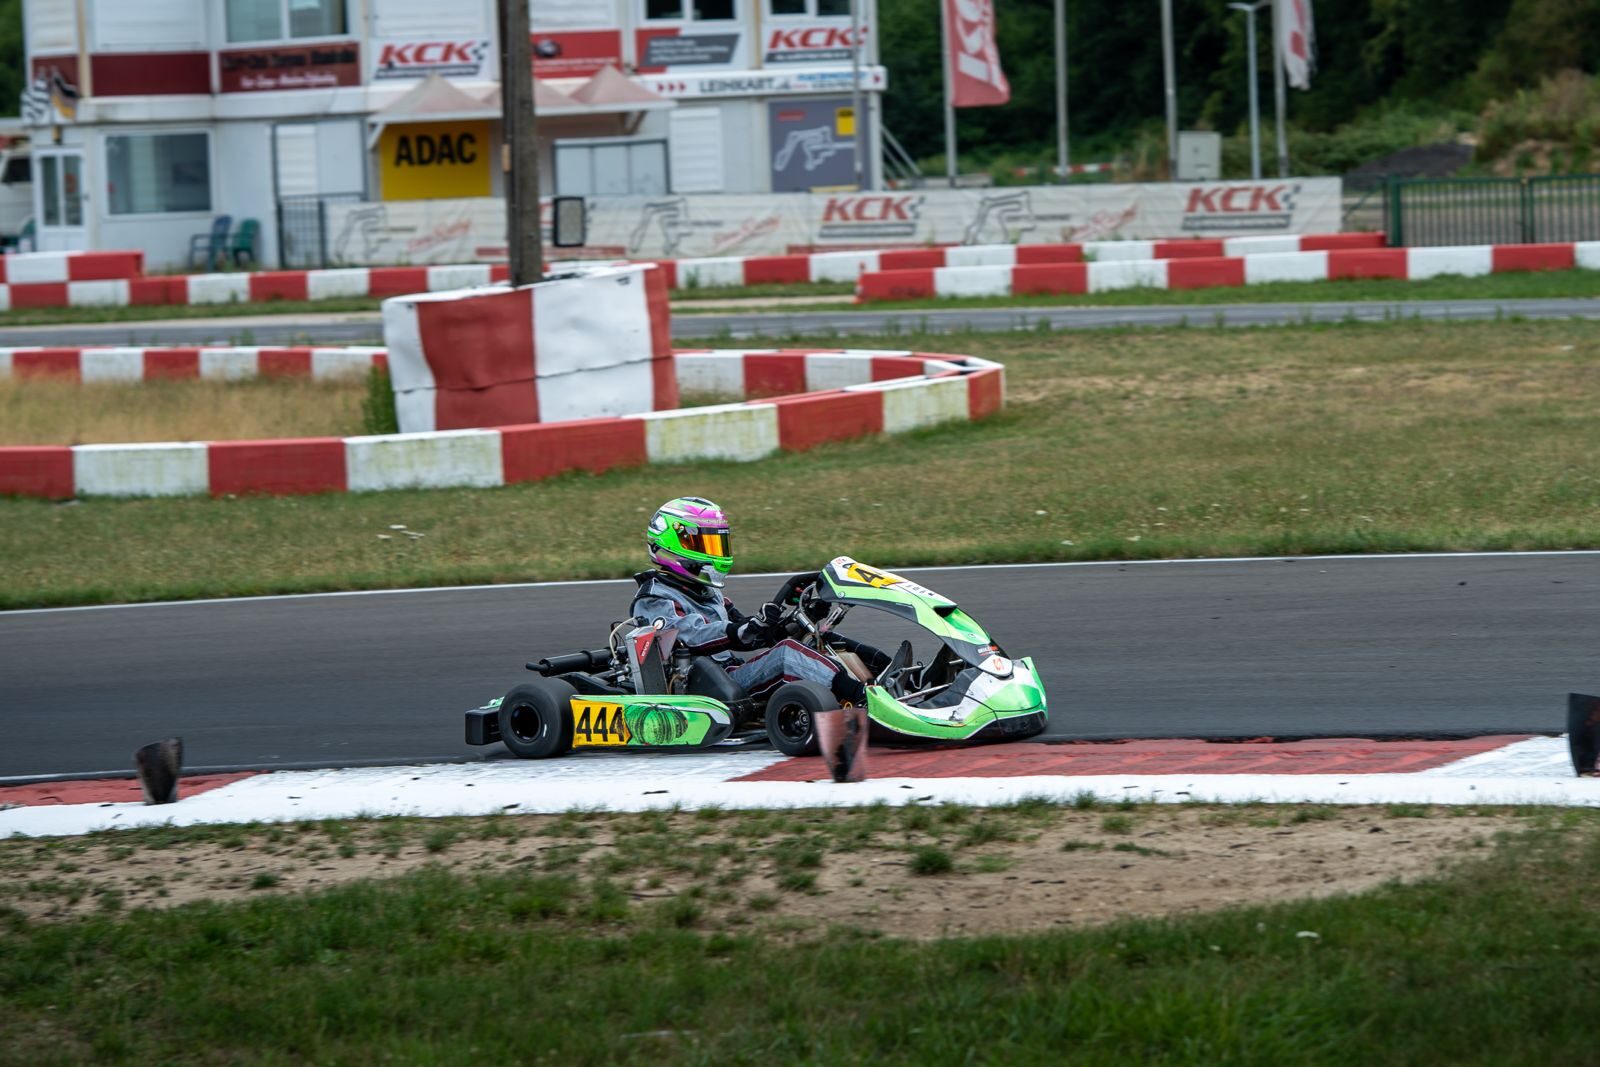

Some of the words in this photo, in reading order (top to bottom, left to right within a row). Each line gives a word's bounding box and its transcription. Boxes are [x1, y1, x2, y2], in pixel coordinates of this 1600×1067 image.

[767, 26, 854, 48] KCK
[379, 41, 476, 64] KCK
[395, 132, 477, 167] ADAC
[823, 197, 912, 222] KCK
[1186, 185, 1285, 213] KCK
[576, 706, 625, 742] 444
